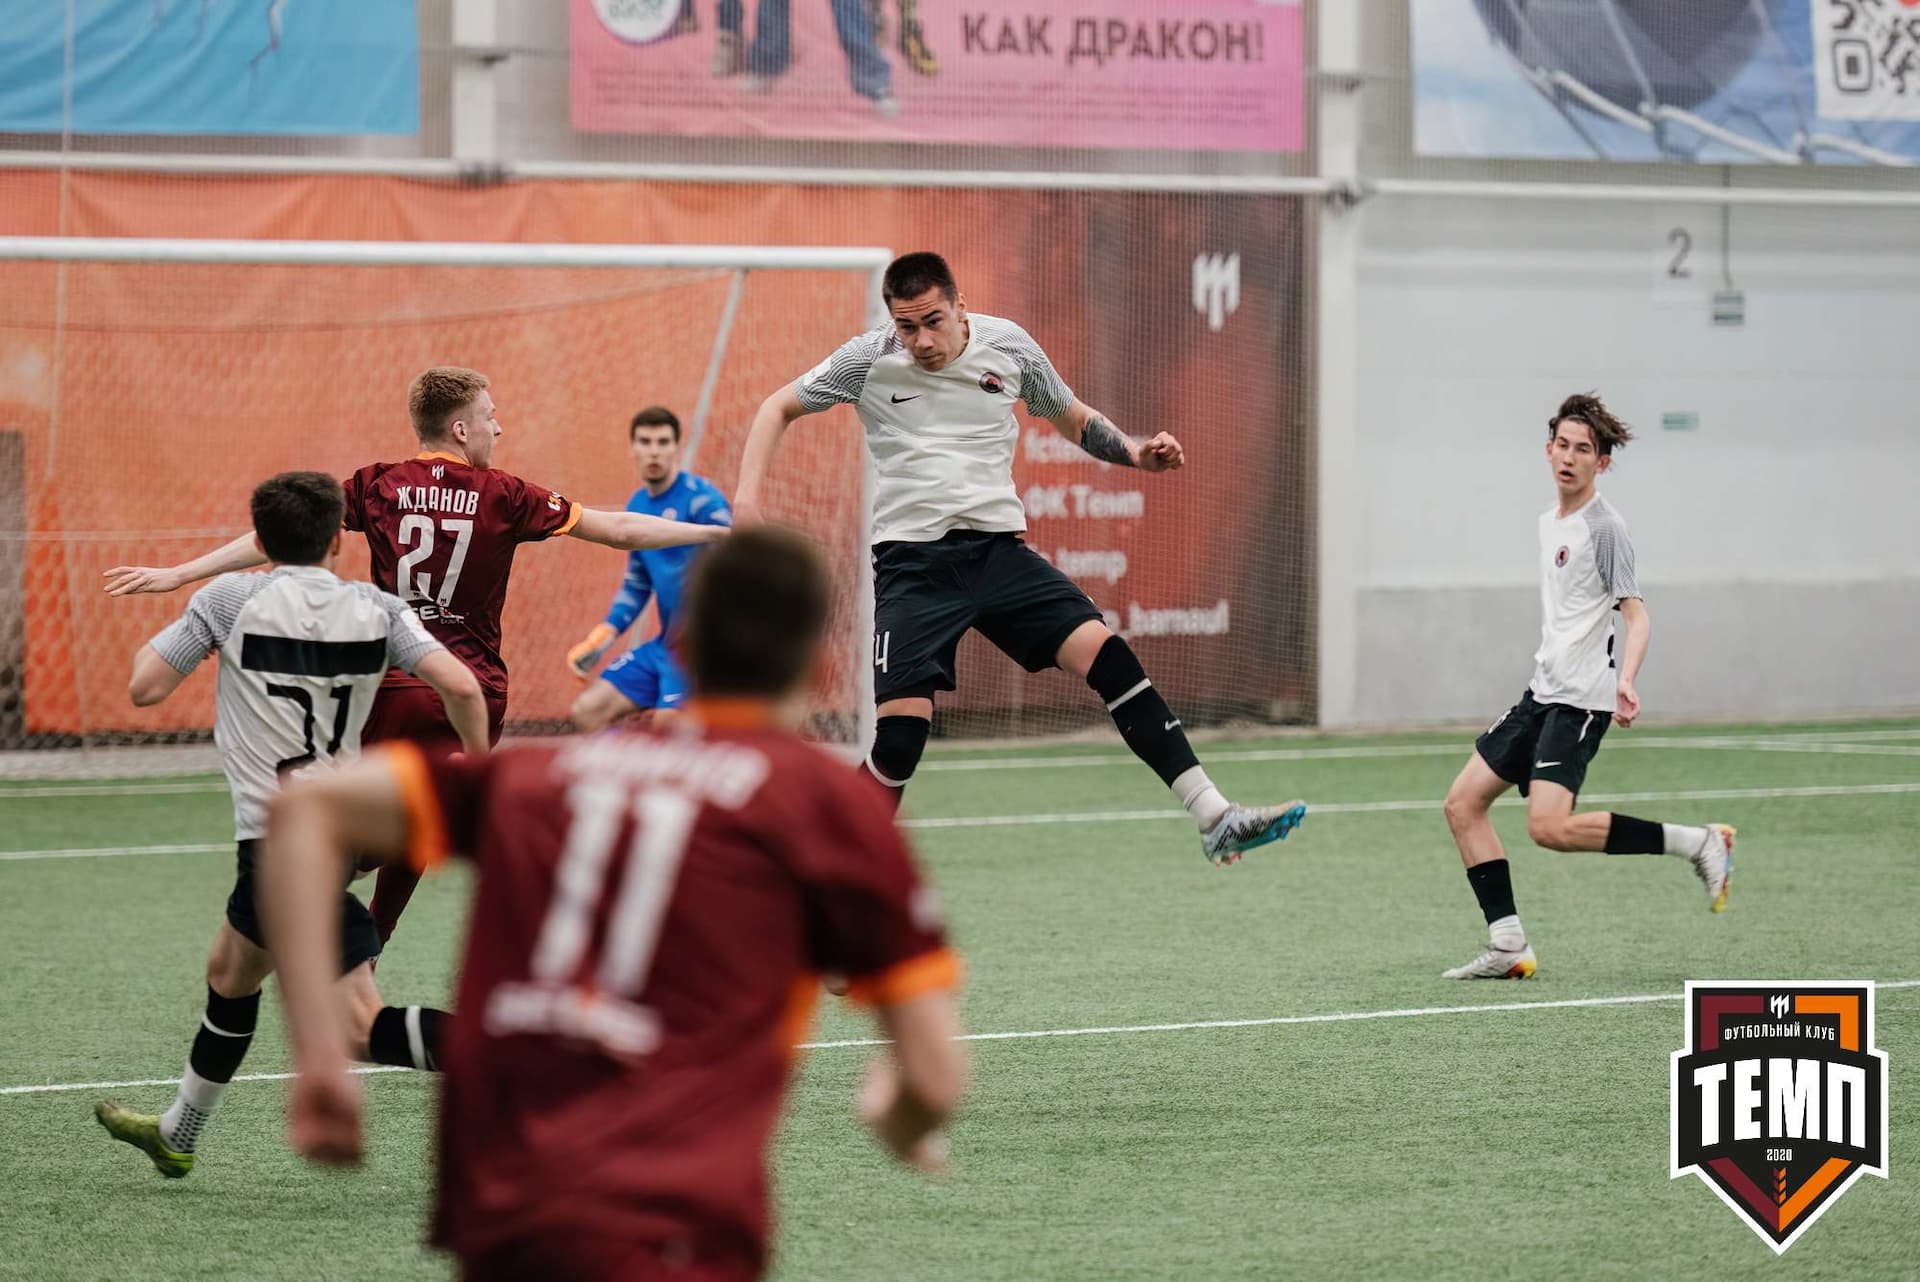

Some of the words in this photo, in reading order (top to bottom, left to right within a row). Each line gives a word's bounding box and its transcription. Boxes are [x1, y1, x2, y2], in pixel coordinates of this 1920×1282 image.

[962, 13, 1053, 55] КАК
[1068, 17, 1264, 67] ДРАКОН!
[1667, 228, 1693, 280] 2
[397, 486, 480, 516] ЖДАНОВ
[397, 514, 475, 607] 27
[530, 780, 700, 998] 11
